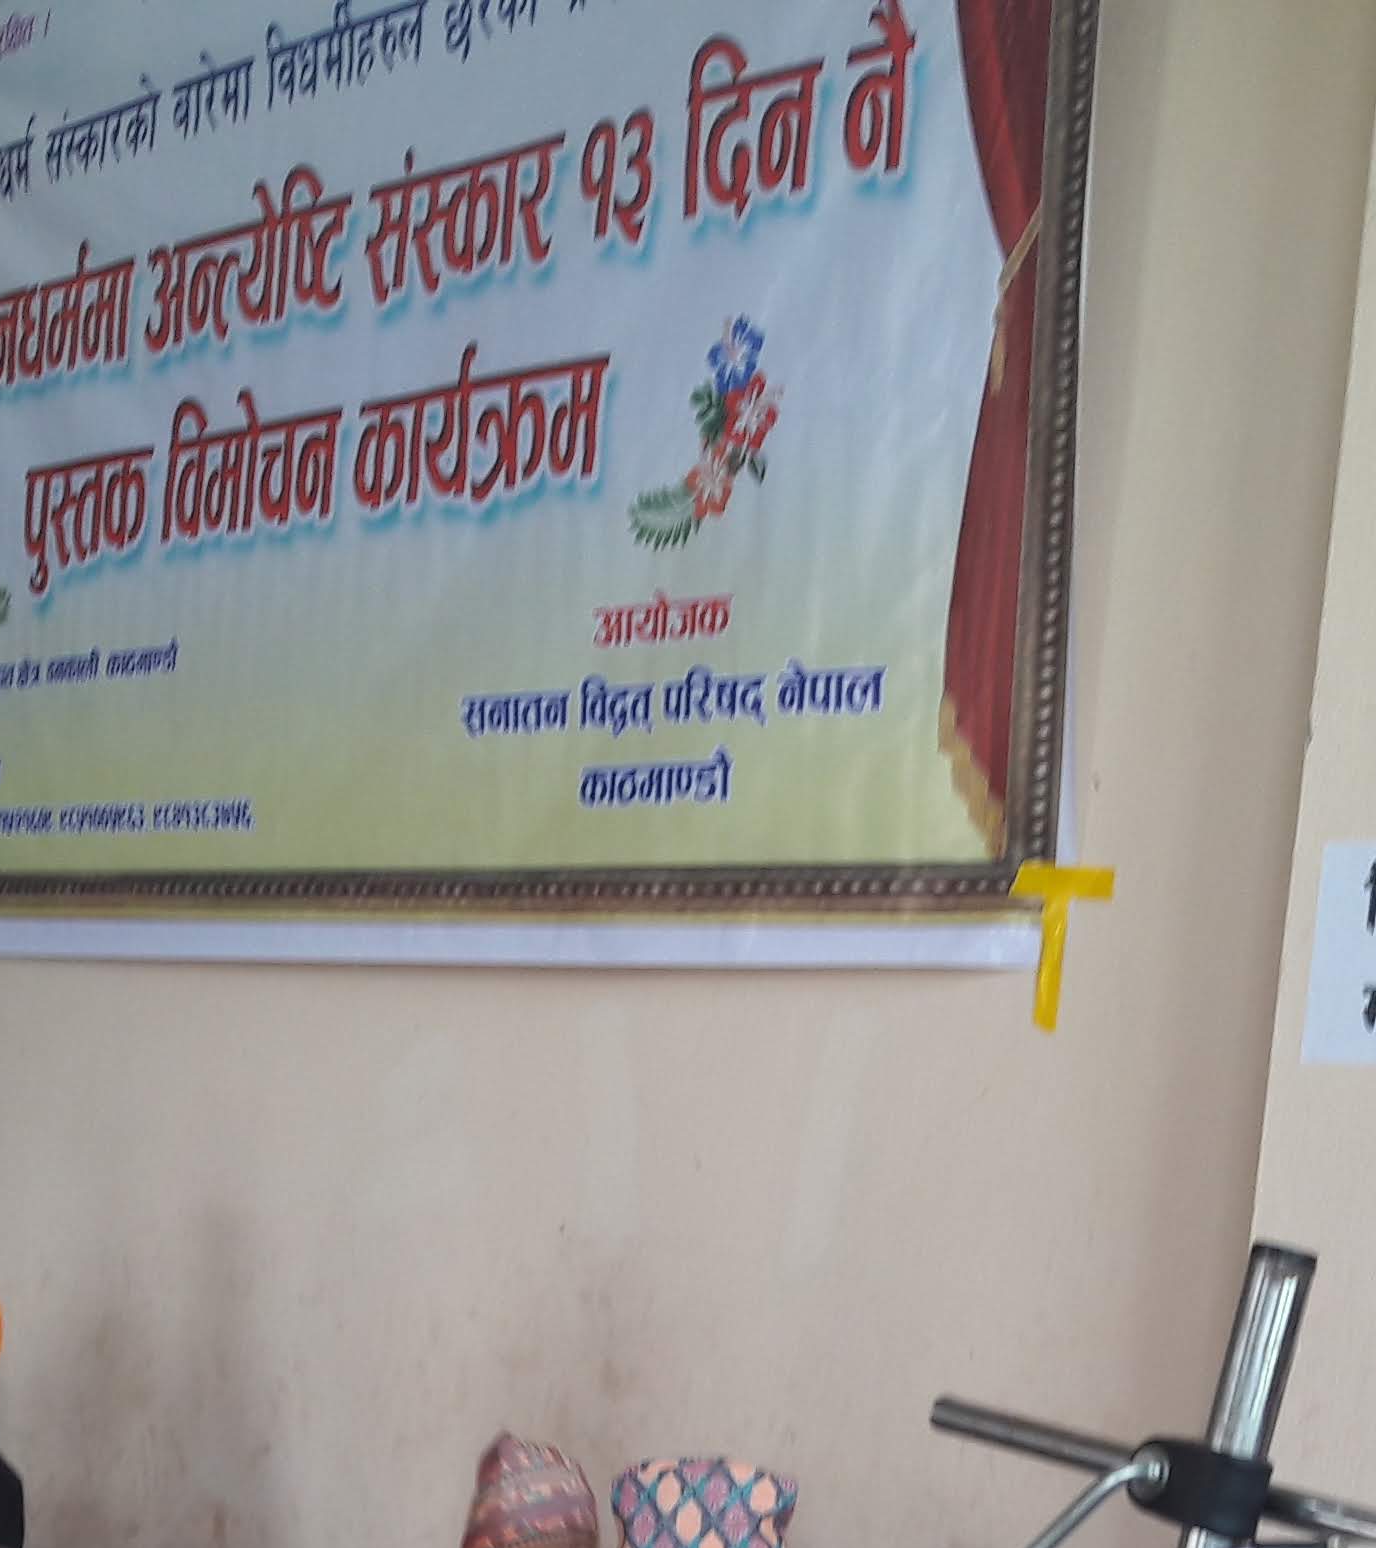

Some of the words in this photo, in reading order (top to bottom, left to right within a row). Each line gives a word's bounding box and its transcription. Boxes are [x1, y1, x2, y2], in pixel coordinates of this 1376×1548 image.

[45, 73, 162, 184] संस्कारको
[365, 131, 565, 302] संस्कार
[581, 107, 654, 242] १३
[683, 34, 824, 220] दिन
[844, 0, 916, 173] नै
[24, 444, 154, 595] पुस्तक
[160, 387, 342, 543] विमोचन
[353, 341, 611, 510] कार्यक्रम
[591, 585, 735, 649] आयोजक
[460, 688, 571, 738] सनातन
[777, 656, 887, 716] नेपाल
